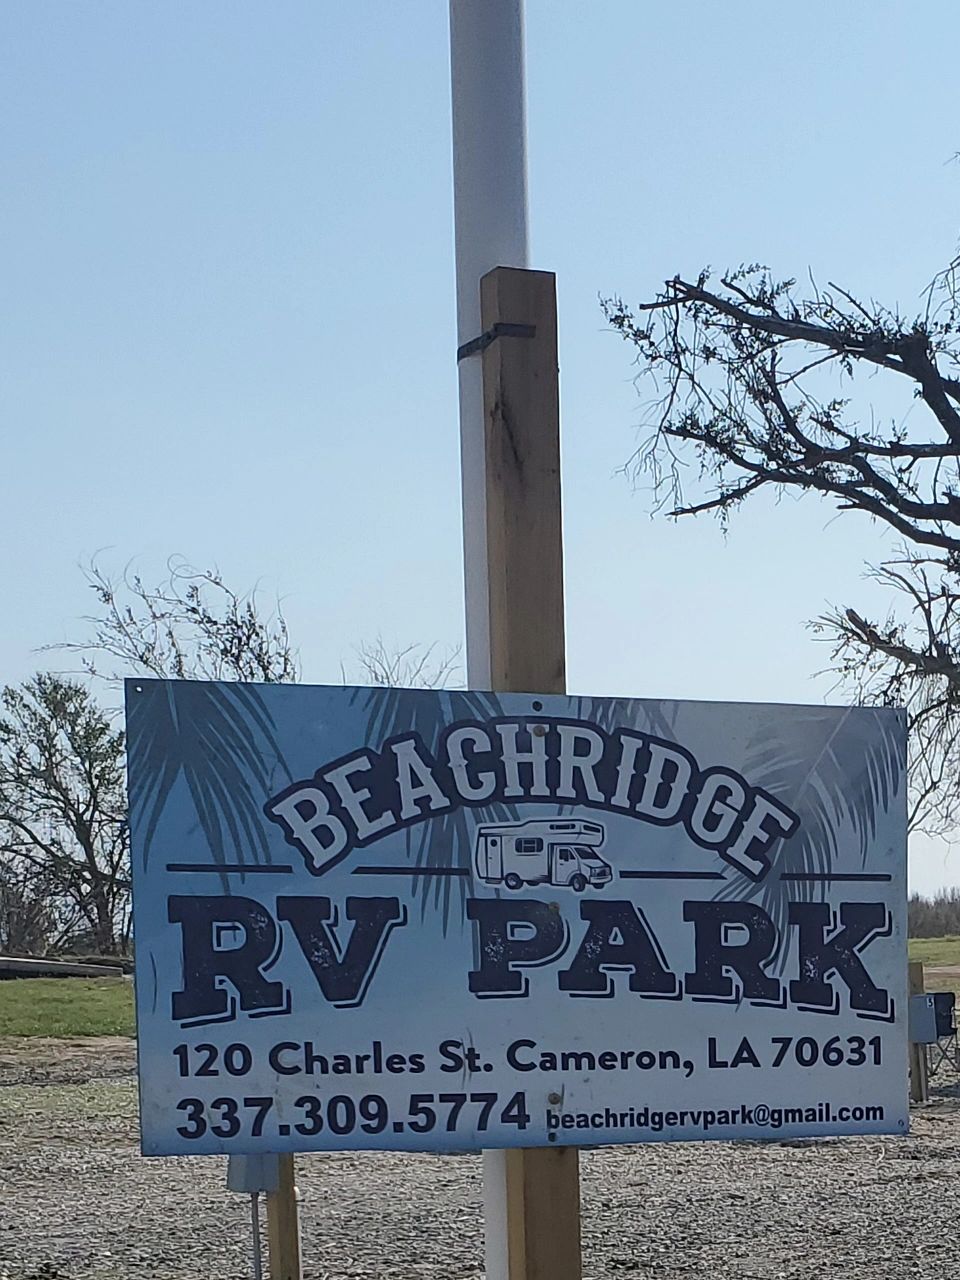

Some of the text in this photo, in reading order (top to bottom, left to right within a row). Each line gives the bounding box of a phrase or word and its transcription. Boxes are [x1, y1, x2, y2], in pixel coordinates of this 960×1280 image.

[267, 718, 798, 880] BEACHRIDGE
[167, 894, 895, 1028] RV PARK
[172, 1035, 883, 1078] 120 Charles St. Cameron, LA 70631
[175, 1091, 885, 1140] 337.309.5774 beachridgervpark@gmail.com
